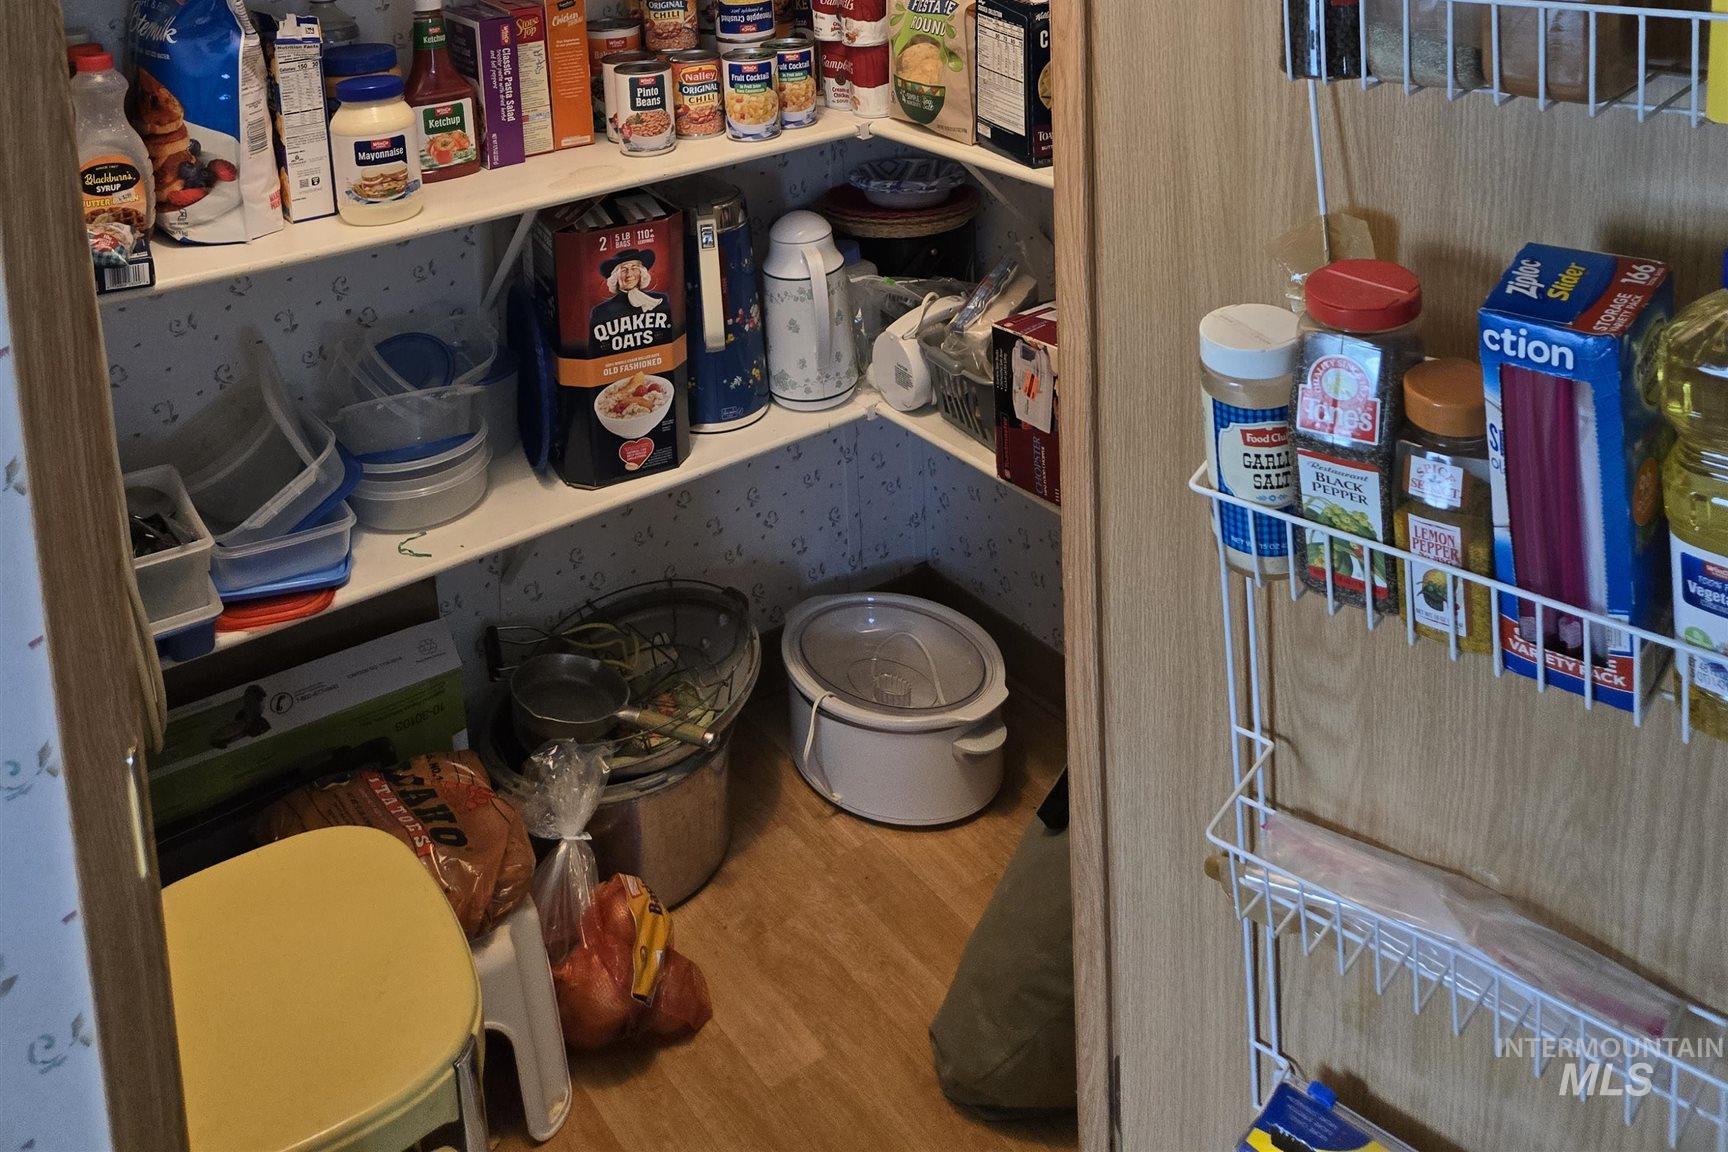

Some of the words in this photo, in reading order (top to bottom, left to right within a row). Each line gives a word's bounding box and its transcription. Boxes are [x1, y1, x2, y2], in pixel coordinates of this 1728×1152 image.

[648, 0, 684, 9] ORIGINAL
[653, 11, 680, 19] CHILI
[516, 16, 539, 36] Stove
[523, 26, 537, 39] Top
[423, 34, 446, 44] Ketchup
[502, 48, 510, 75] Classic
[788, 60, 809, 70] Cocktail
[685, 70, 715, 82] Nalley
[731, 74, 745, 82] Fruit
[746, 73, 769, 82] Cocktail
[504, 76, 513, 99] Pasta
[637, 86, 659, 97] Pinto
[682, 83, 718, 94] ORIGINAL
[636, 96, 661, 107] Beans
[688, 94, 715, 104] CHILI
[506, 100, 516, 122] Salad
[428, 113, 461, 130] Ketchup
[358, 146, 404, 162] Mayonnaise
[85, 171, 134, 186] Blackburn's
[96, 183, 121, 193] SYRUP
[599, 236, 607, 252] 2
[615, 239, 631, 249] BAGS
[1505, 258, 1546, 300] Ziploc
[1547, 261, 1586, 302] Slider
[1620, 264, 1657, 285] 166
[1592, 291, 1632, 332] STORAGE
[1628, 294, 1645, 315] PACK
[593, 312, 668, 342] QUAKER
[611, 329, 654, 351] OATS
[603, 366, 619, 377] OLD
[619, 358, 662, 374] FASHIONED
[1304, 396, 1373, 433] Tone's
[1246, 433, 1269, 443] Food
[1270, 432, 1288, 442] Clu
[1243, 450, 1291, 470] GARLI
[1253, 470, 1291, 490] SALT
[1315, 471, 1363, 494] BLACK
[1312, 481, 1369, 505] PEPPER
[1414, 525, 1455, 547] LEMON
[1412, 536, 1460, 564] PEPPER
